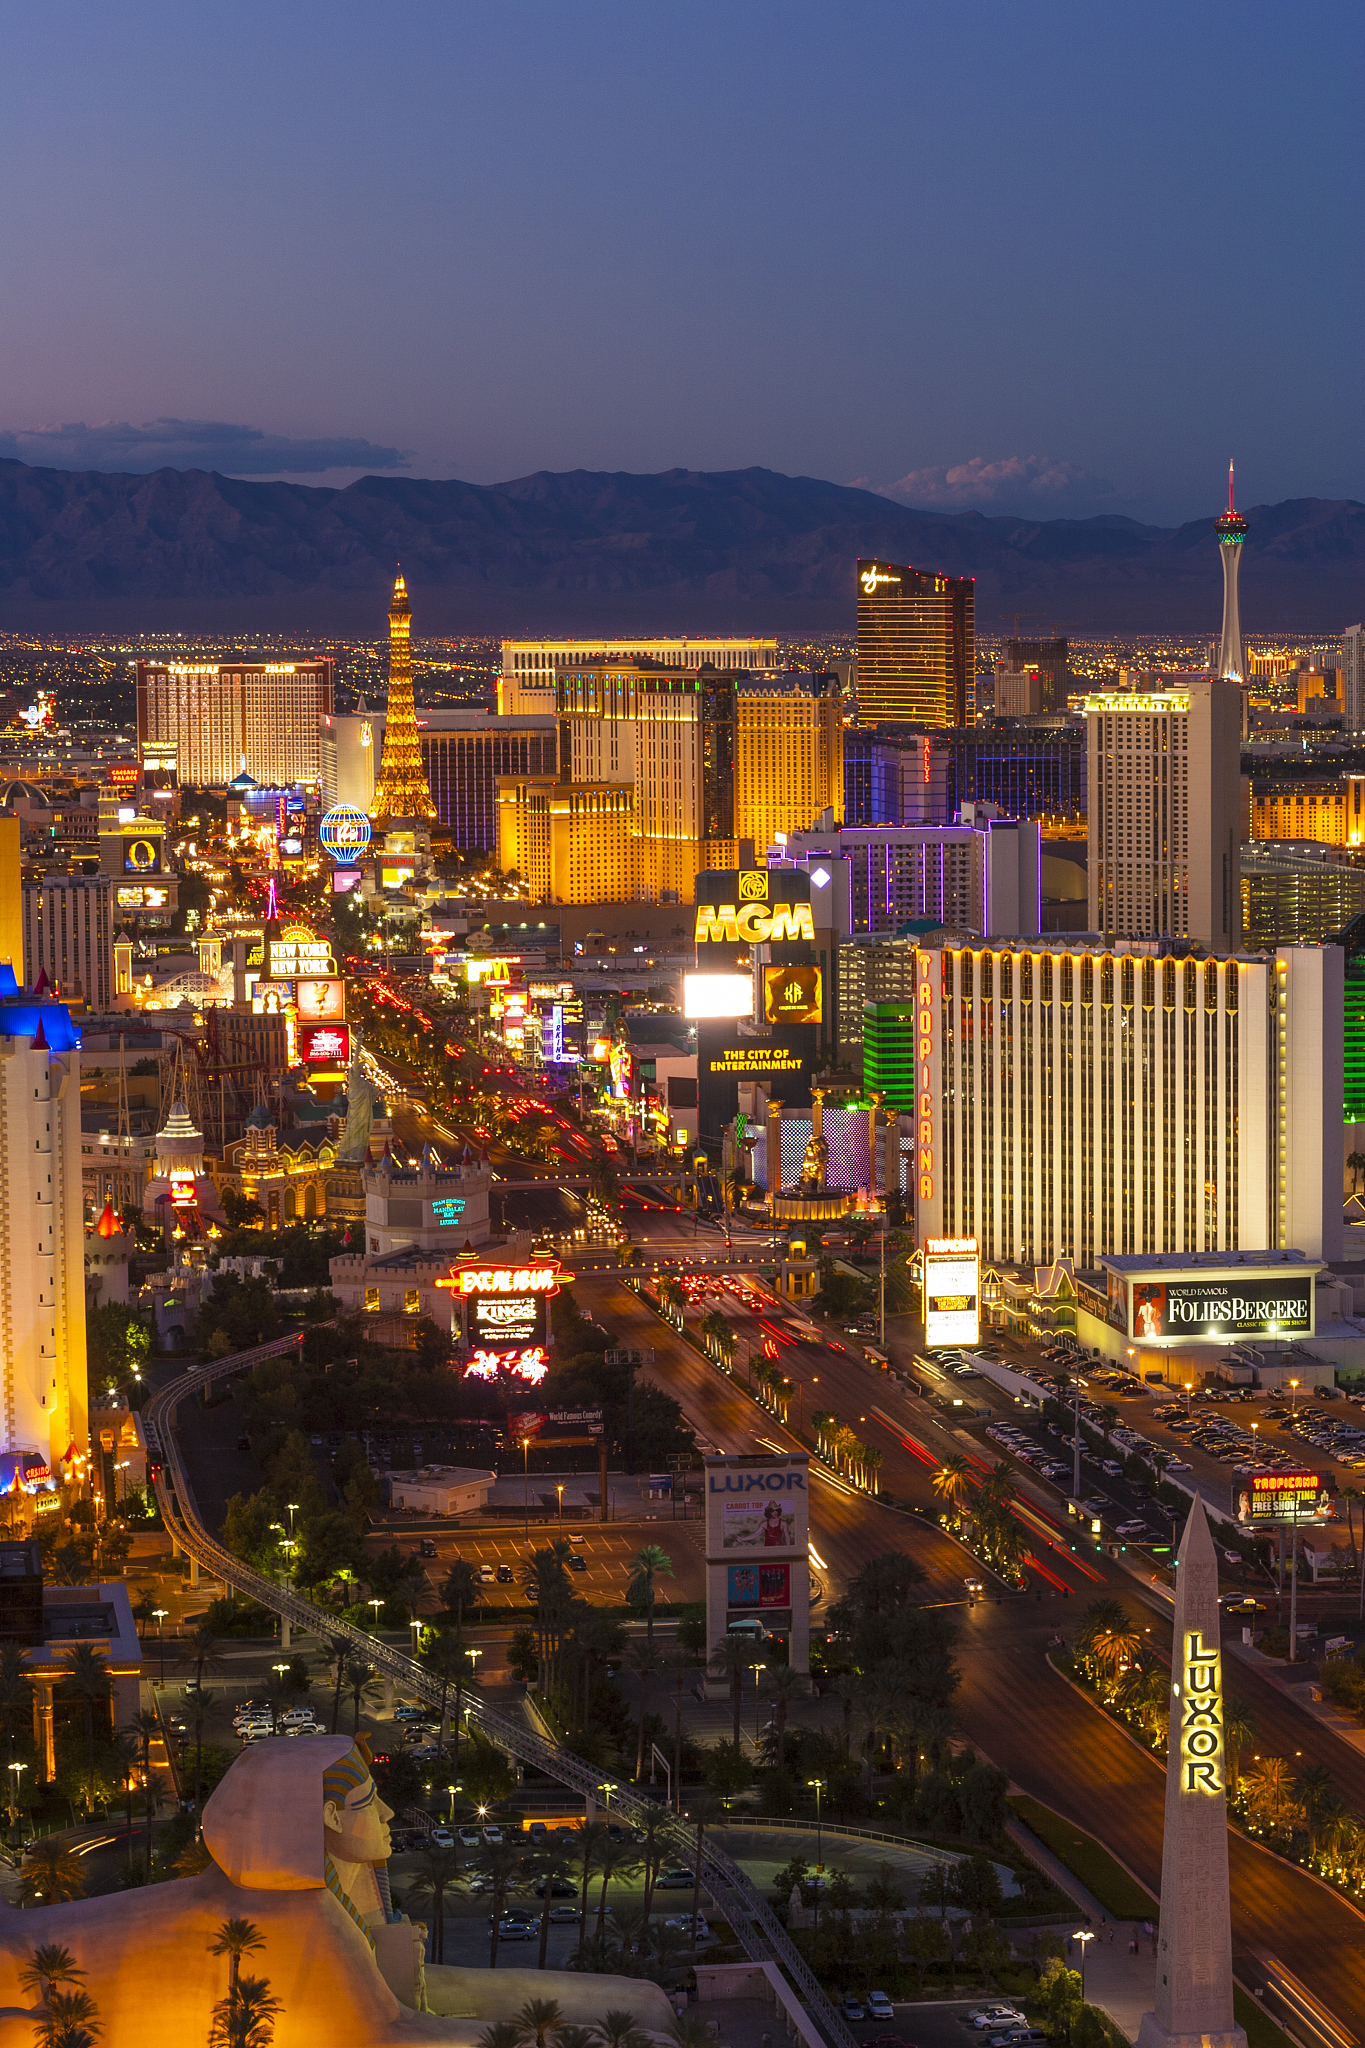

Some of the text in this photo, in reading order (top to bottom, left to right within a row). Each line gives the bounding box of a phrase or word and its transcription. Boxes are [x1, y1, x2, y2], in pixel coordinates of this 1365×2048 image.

[167, 666, 220, 674] TREASURE
[695, 903, 815, 942] MGM
[234, 929, 264, 937] Monte
[270, 943, 329, 957] NEW YORK
[271, 960, 329, 973] NEW YORK
[255, 983, 291, 994] RITA
[724, 1049, 789, 1060] THE CITY OF
[710, 1060, 802, 1071] ENTERTAINMENT
[919, 954, 933, 1199] TROPICANA
[462, 1269, 554, 1292] EXCALIBUR
[1169, 1287, 1228, 1296] WORLD FAMOUS
[476, 1304, 537, 1325] KINGS
[1168, 1298, 1307, 1322] FOLIES BERGERE
[549, 1410, 602, 1420] World Famous Comedy!
[26, 1466, 50, 1479] CASINO
[710, 1473, 807, 1492] LUXOR
[1253, 1476, 1318, 1489] TROPICANA
[1252, 1490, 1316, 1502] MOST EXCTING
[1252, 1501, 1272, 1511] FREE
[1185, 1634, 1222, 1791] LUXOR
